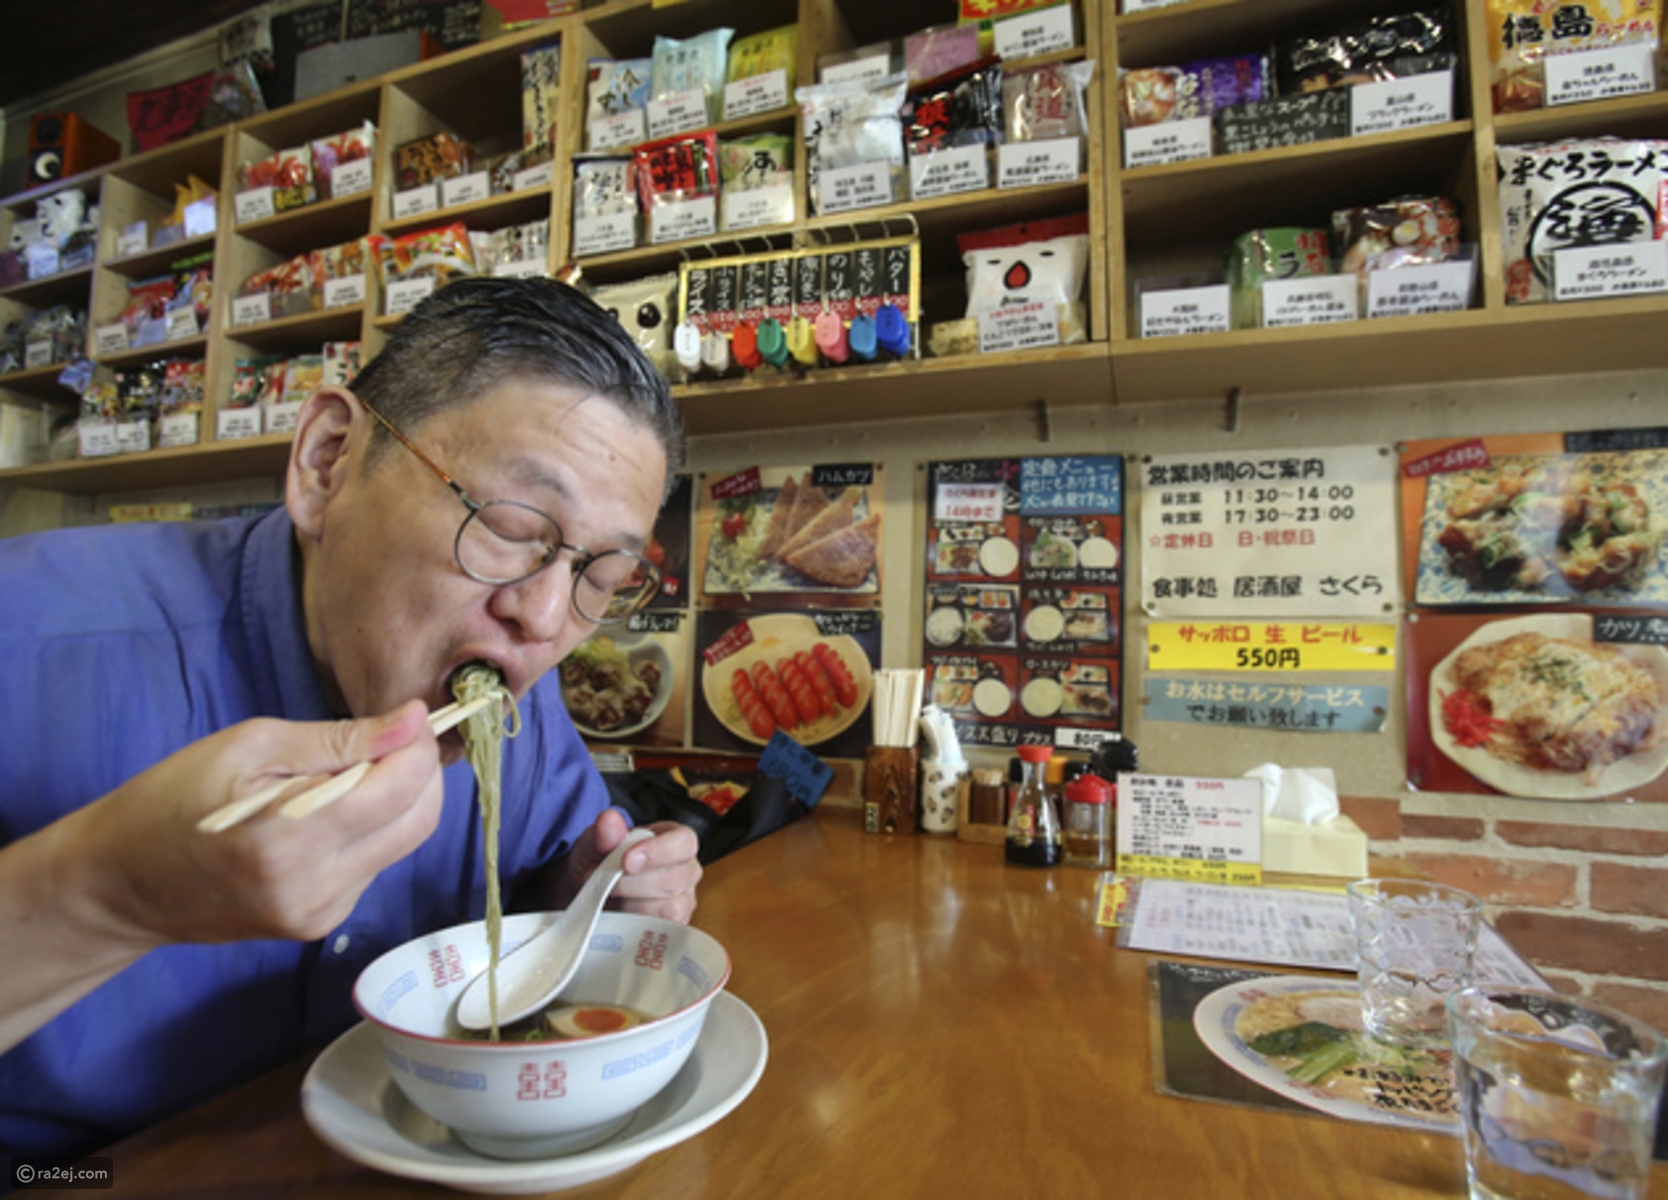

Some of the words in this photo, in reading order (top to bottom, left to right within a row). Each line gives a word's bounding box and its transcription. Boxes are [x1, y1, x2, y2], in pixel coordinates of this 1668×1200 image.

[1502, 4, 1594, 50] 徳島
[889, 246, 910, 292] バター
[1148, 458, 1325, 485] 営業時間のご案内
[1152, 577, 1218, 599] 食事処
[1233, 576, 1302, 598] 居酒屋
[1319, 575, 1383, 597] さくら
[1178, 626, 1250, 644] サッポロ
[1265, 626, 1286, 644] 生
[1302, 626, 1363, 645] ビール
[1236, 648, 1300, 668] 550円
[1165, 681, 1364, 707] お水はセルフサービス
[1187, 704, 1341, 728] でお願い致します
